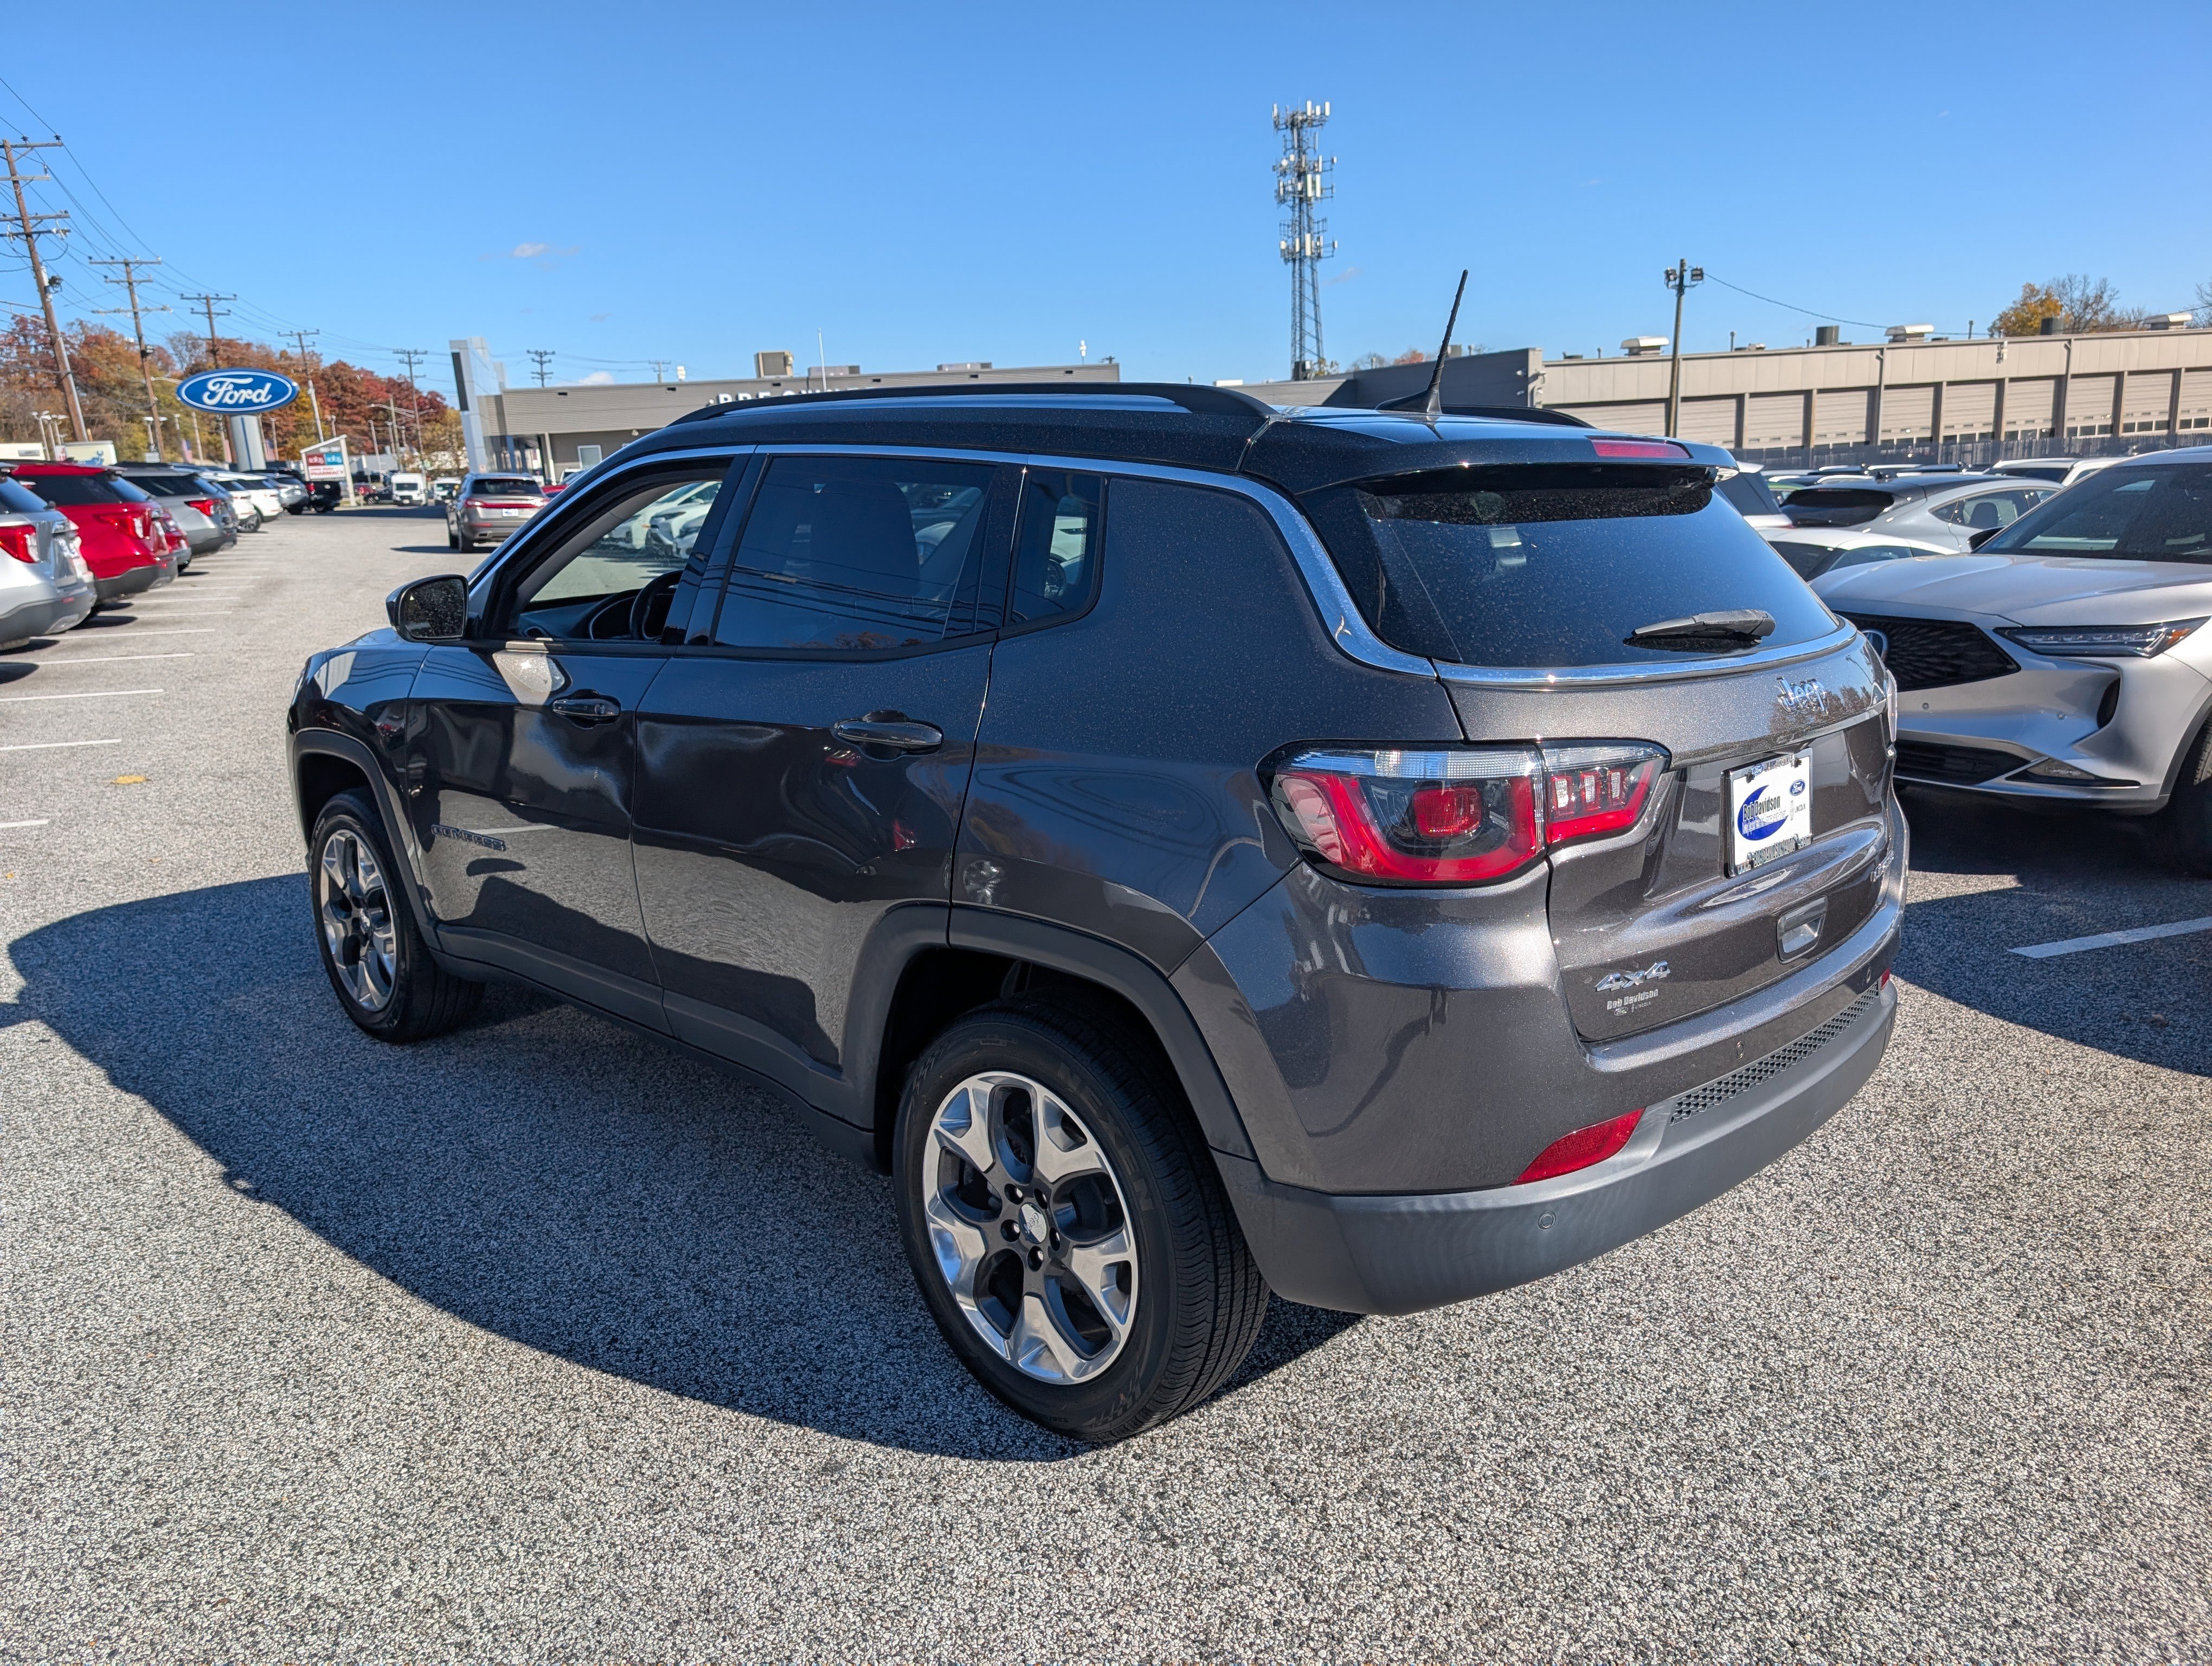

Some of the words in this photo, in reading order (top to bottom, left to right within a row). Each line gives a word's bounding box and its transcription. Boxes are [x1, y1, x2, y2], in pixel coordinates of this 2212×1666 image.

[202, 377, 272, 406] Ford
[1777, 676, 1827, 715] Jeep
[1744, 802, 1754, 821] Bob
[1754, 795, 1780, 816] Davidson
[1595, 960, 1670, 992] 4x4
[1606, 998, 1623, 1010] Bob
[1623, 989, 1659, 1005] Davidson
[1023, 1212, 1039, 1234] Jeep
